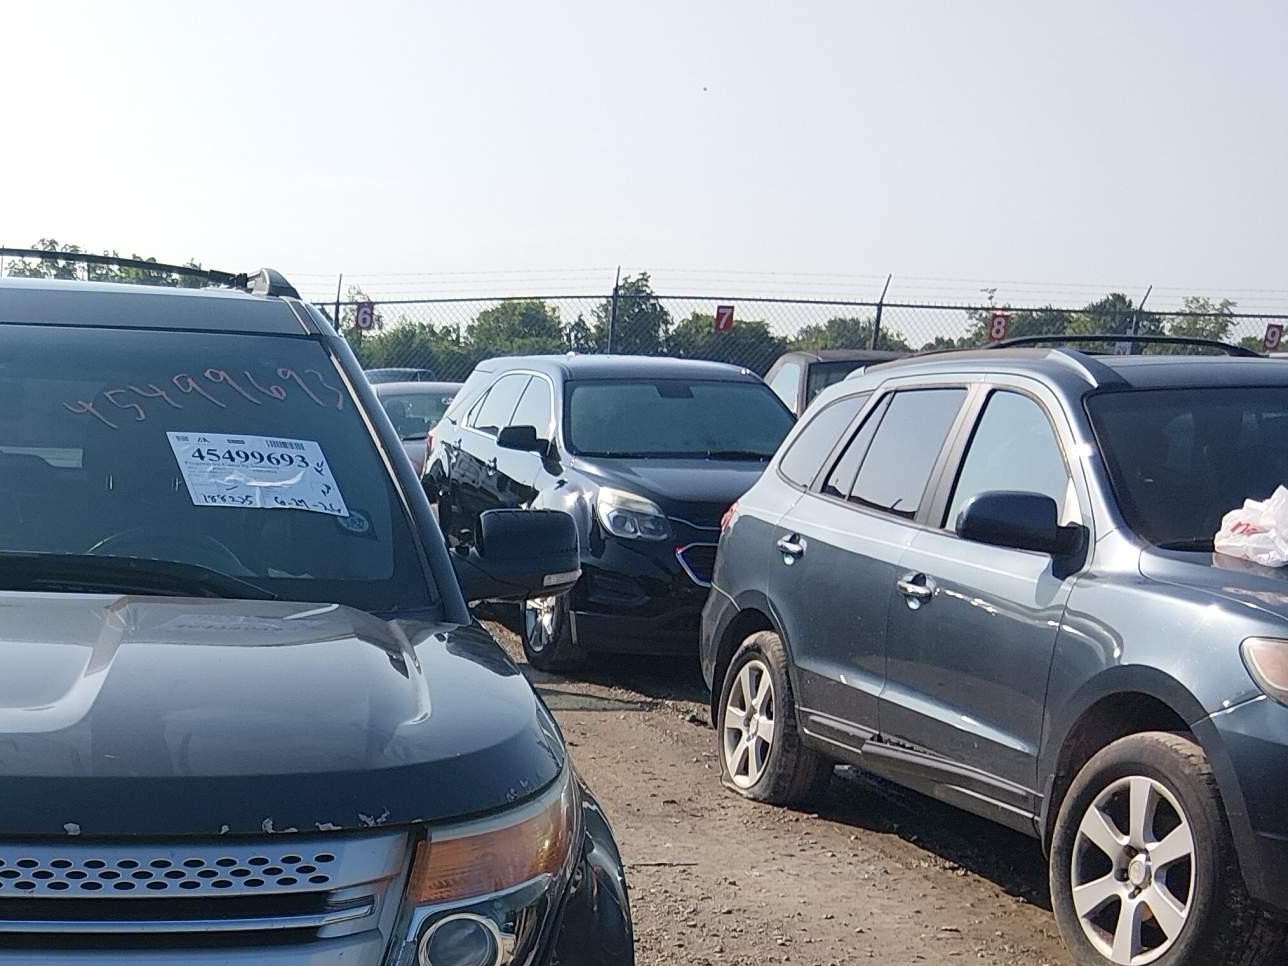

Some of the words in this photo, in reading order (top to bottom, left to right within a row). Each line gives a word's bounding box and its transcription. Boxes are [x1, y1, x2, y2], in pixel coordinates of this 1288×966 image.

[358, 307, 371, 328] 6
[718, 308, 733, 329] 7
[992, 317, 1006, 339] 8
[1264, 326, 1280, 349] 9
[63, 368, 344, 429] 45499693
[191, 447, 310, 469] 45499693
